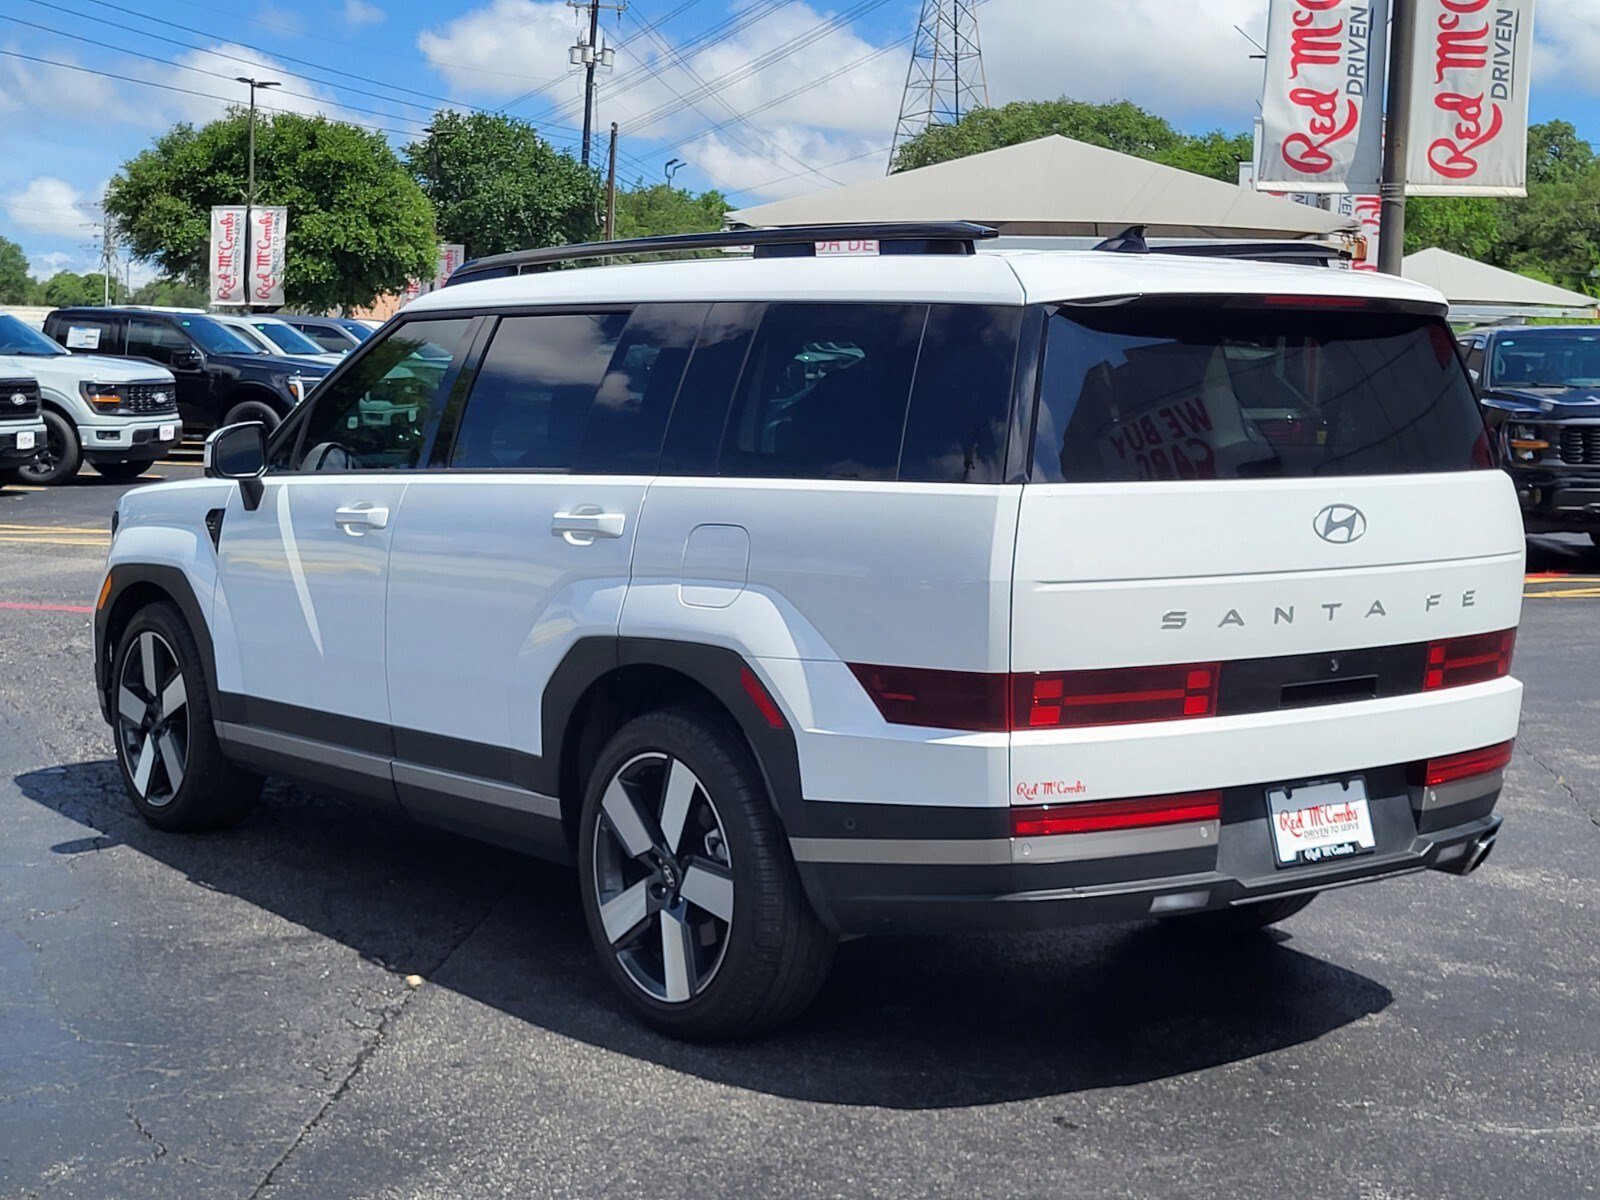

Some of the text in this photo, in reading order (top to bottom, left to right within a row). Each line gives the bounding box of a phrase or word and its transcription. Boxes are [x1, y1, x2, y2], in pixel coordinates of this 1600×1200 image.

[1346, 6, 1367, 96] DRIVEN
[1491, 9, 1514, 100] DRIVEN
[1282, 88, 1358, 174] Red
[1427, 92, 1503, 179] Red
[1160, 590, 1476, 630] SANTA FE
[1016, 780, 1086, 800] Red McCombs
[1279, 802, 1358, 838] Red McCombs
[1304, 827, 1329, 839] DRIVEN
[1331, 826, 1340, 834] TO
